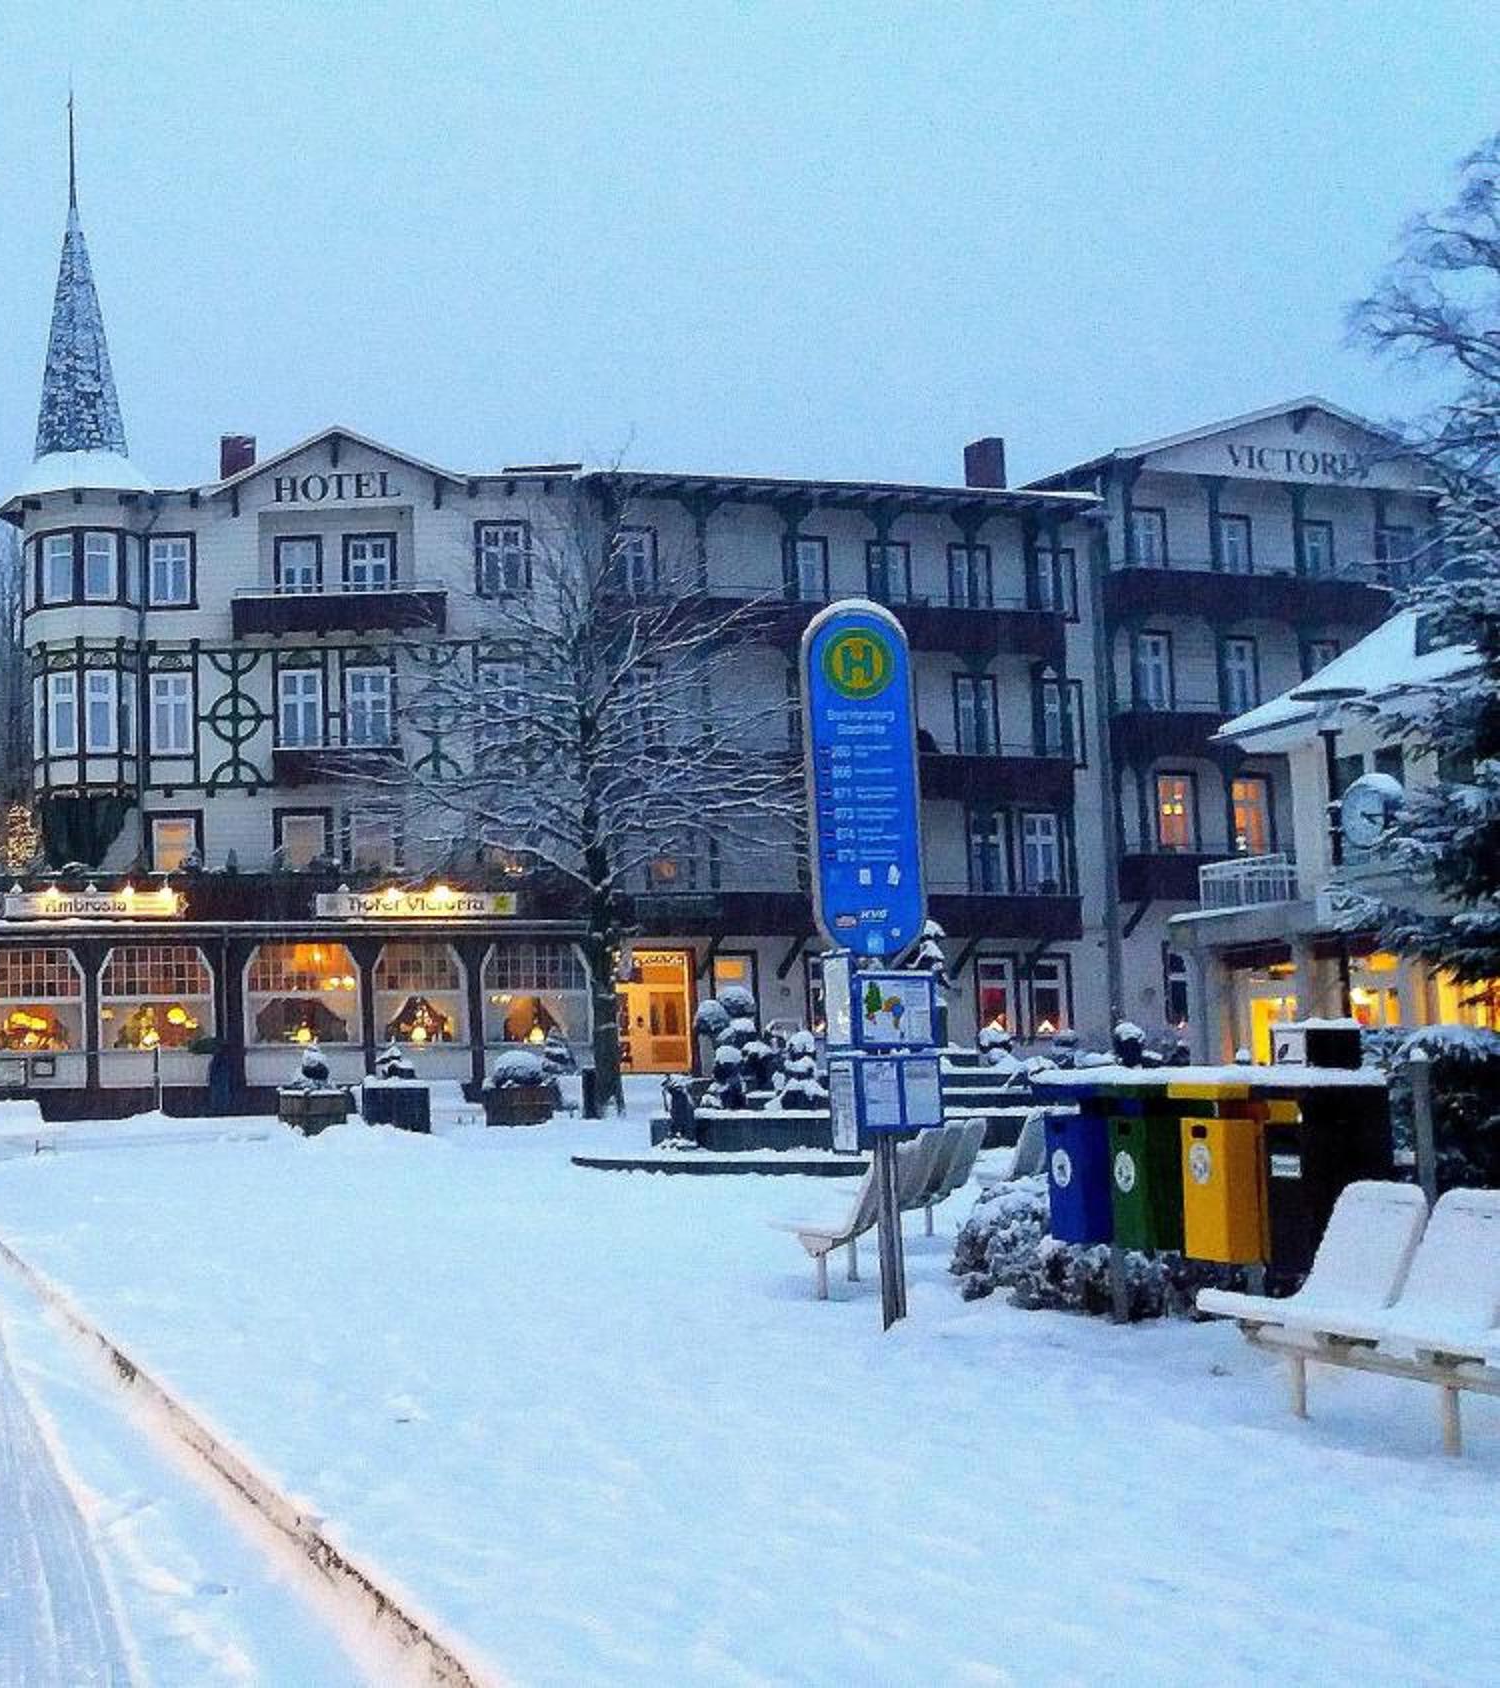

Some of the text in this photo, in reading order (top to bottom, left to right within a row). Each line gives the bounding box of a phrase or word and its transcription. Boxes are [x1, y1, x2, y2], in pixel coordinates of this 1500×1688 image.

[273, 472, 401, 503] HOTEL
[842, 645, 873, 680] H
[45, 897, 128, 913] Ambrosia
